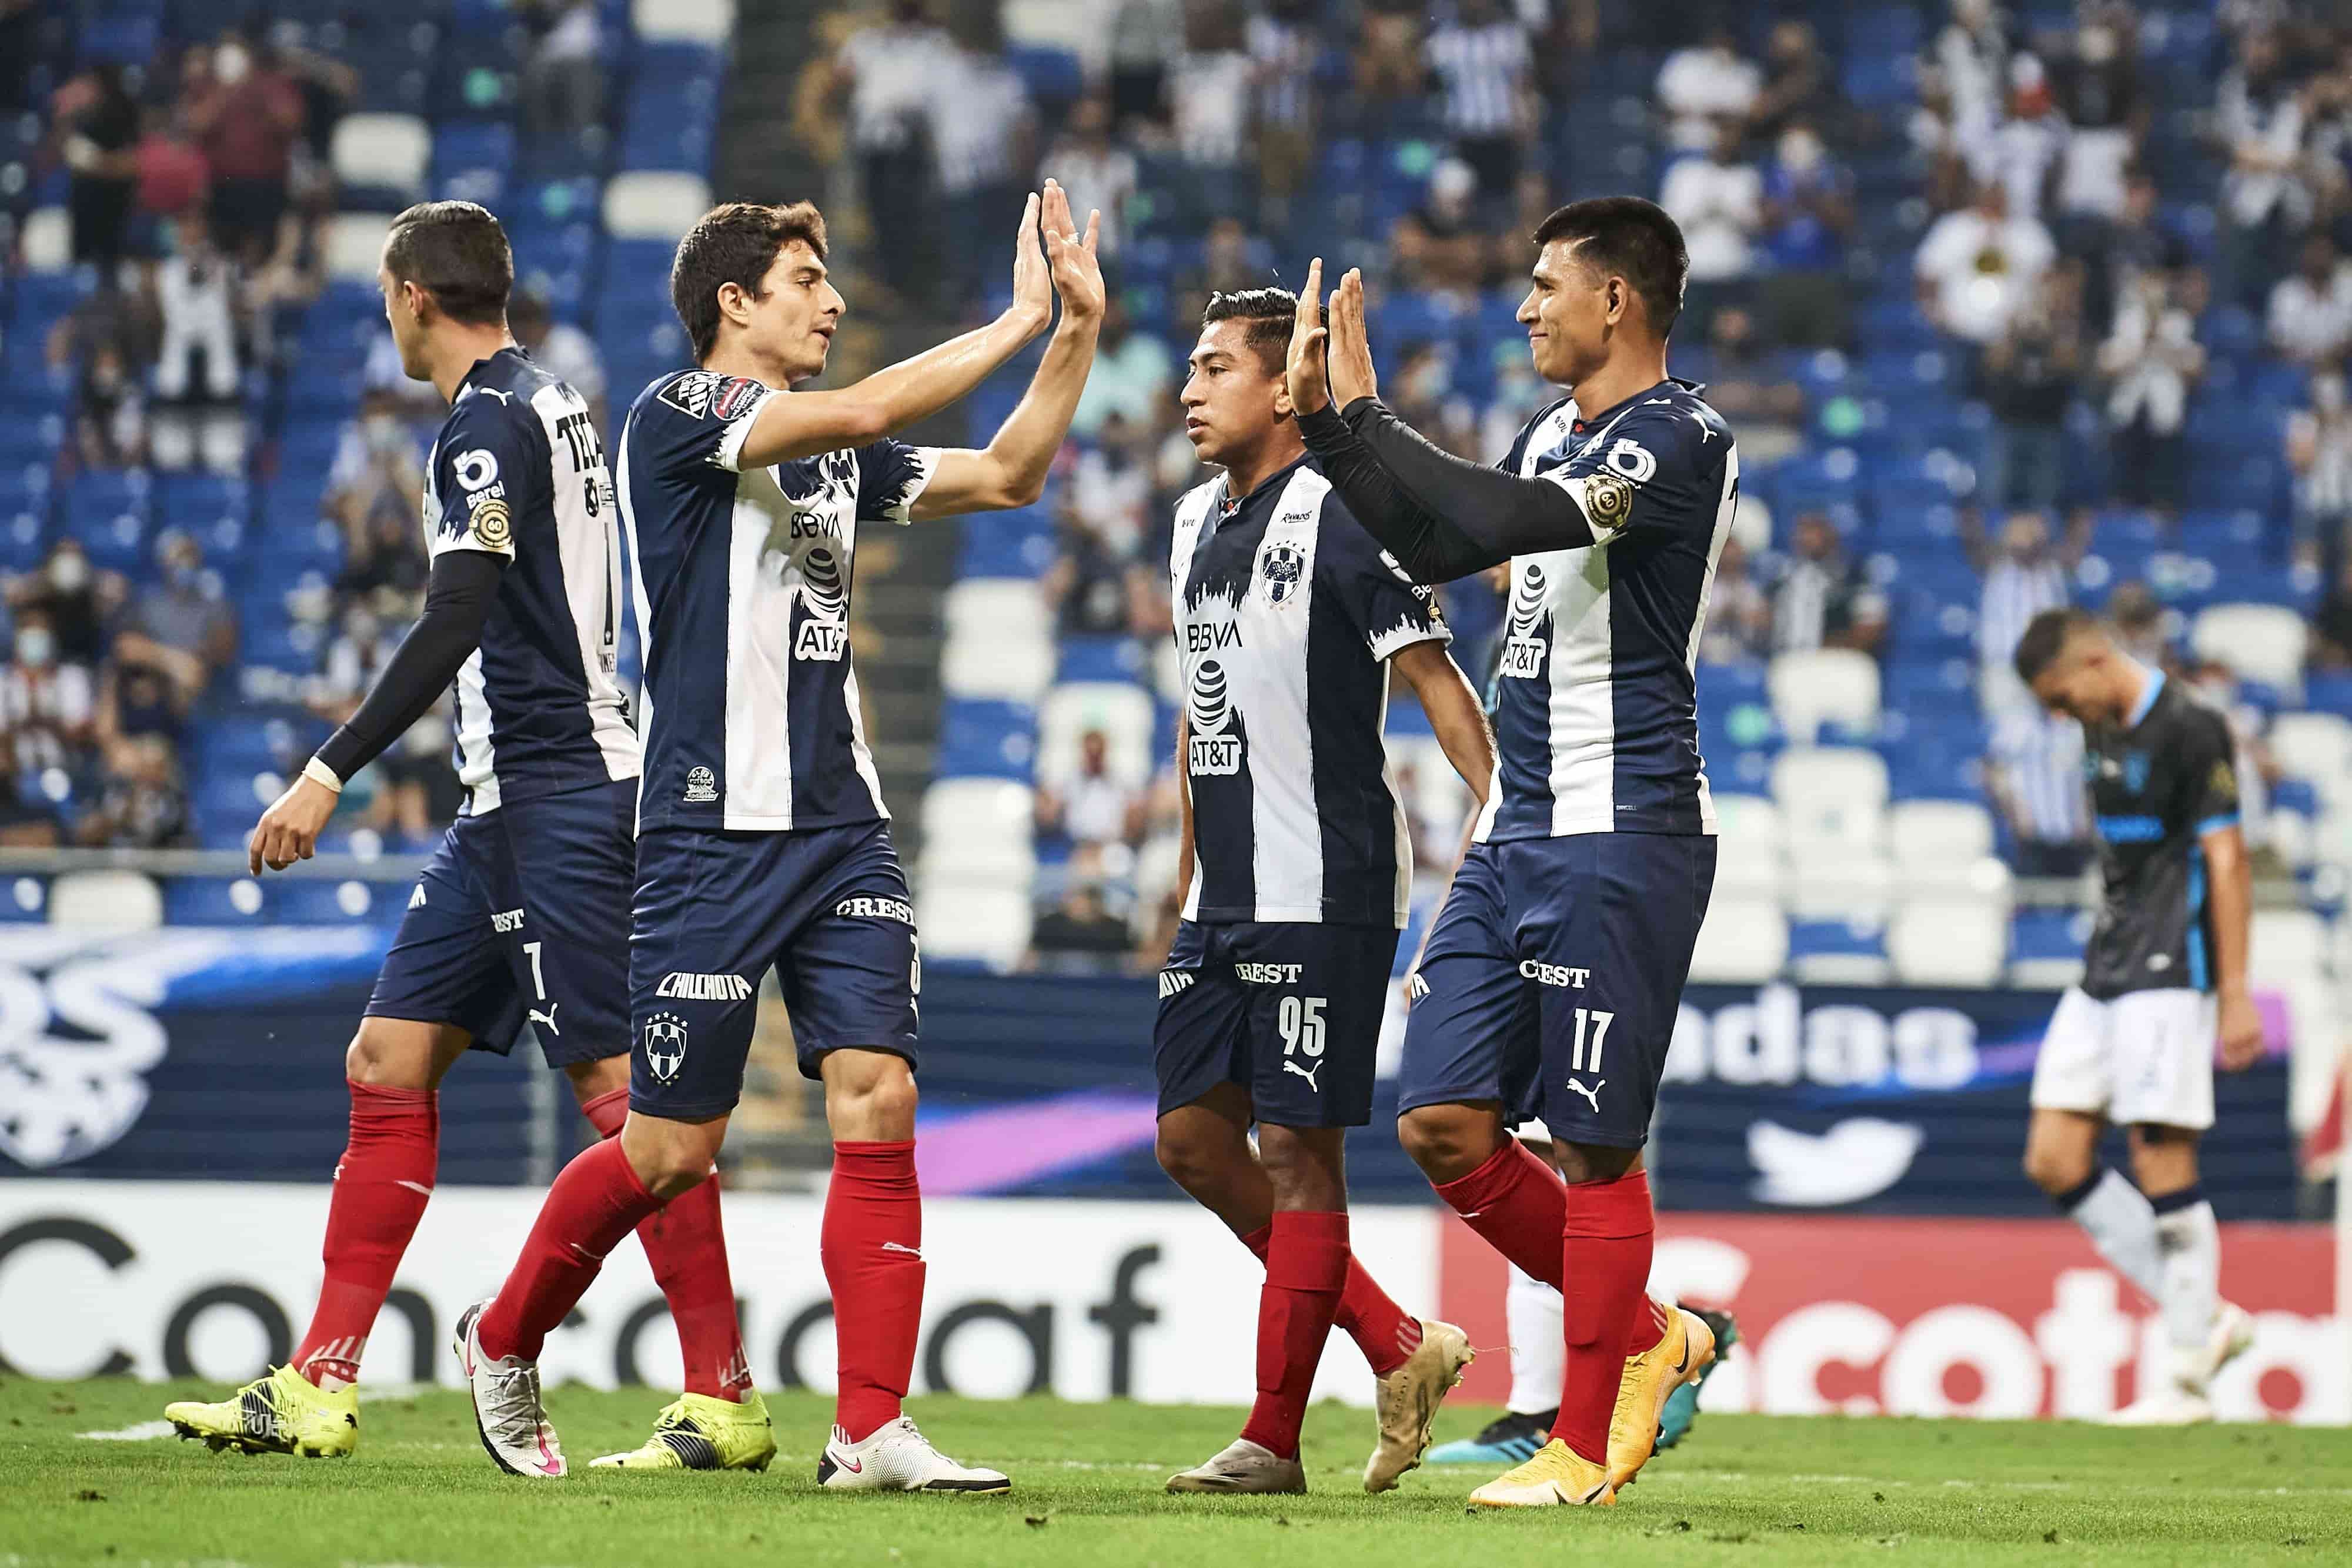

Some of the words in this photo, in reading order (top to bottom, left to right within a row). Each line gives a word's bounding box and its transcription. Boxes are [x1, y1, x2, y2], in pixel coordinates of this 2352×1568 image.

[466, 480, 506, 510] Berel
[1601, 493, 1615, 508] 60
[487, 520, 503, 531] 60
[1187, 618, 1242, 653] BBVA
[1502, 643, 1541, 671] AT&T
[1192, 740, 1238, 767] AT&T
[523, 941, 546, 1000] 7
[1235, 962, 1302, 984] REST
[1519, 959, 1591, 988] CEST
[654, 972, 752, 1000] CHILCHOTA
[1279, 996, 1327, 1057] 95
[1572, 1008, 1615, 1073] 17
[0, 1216, 1160, 1398] Conacaf
